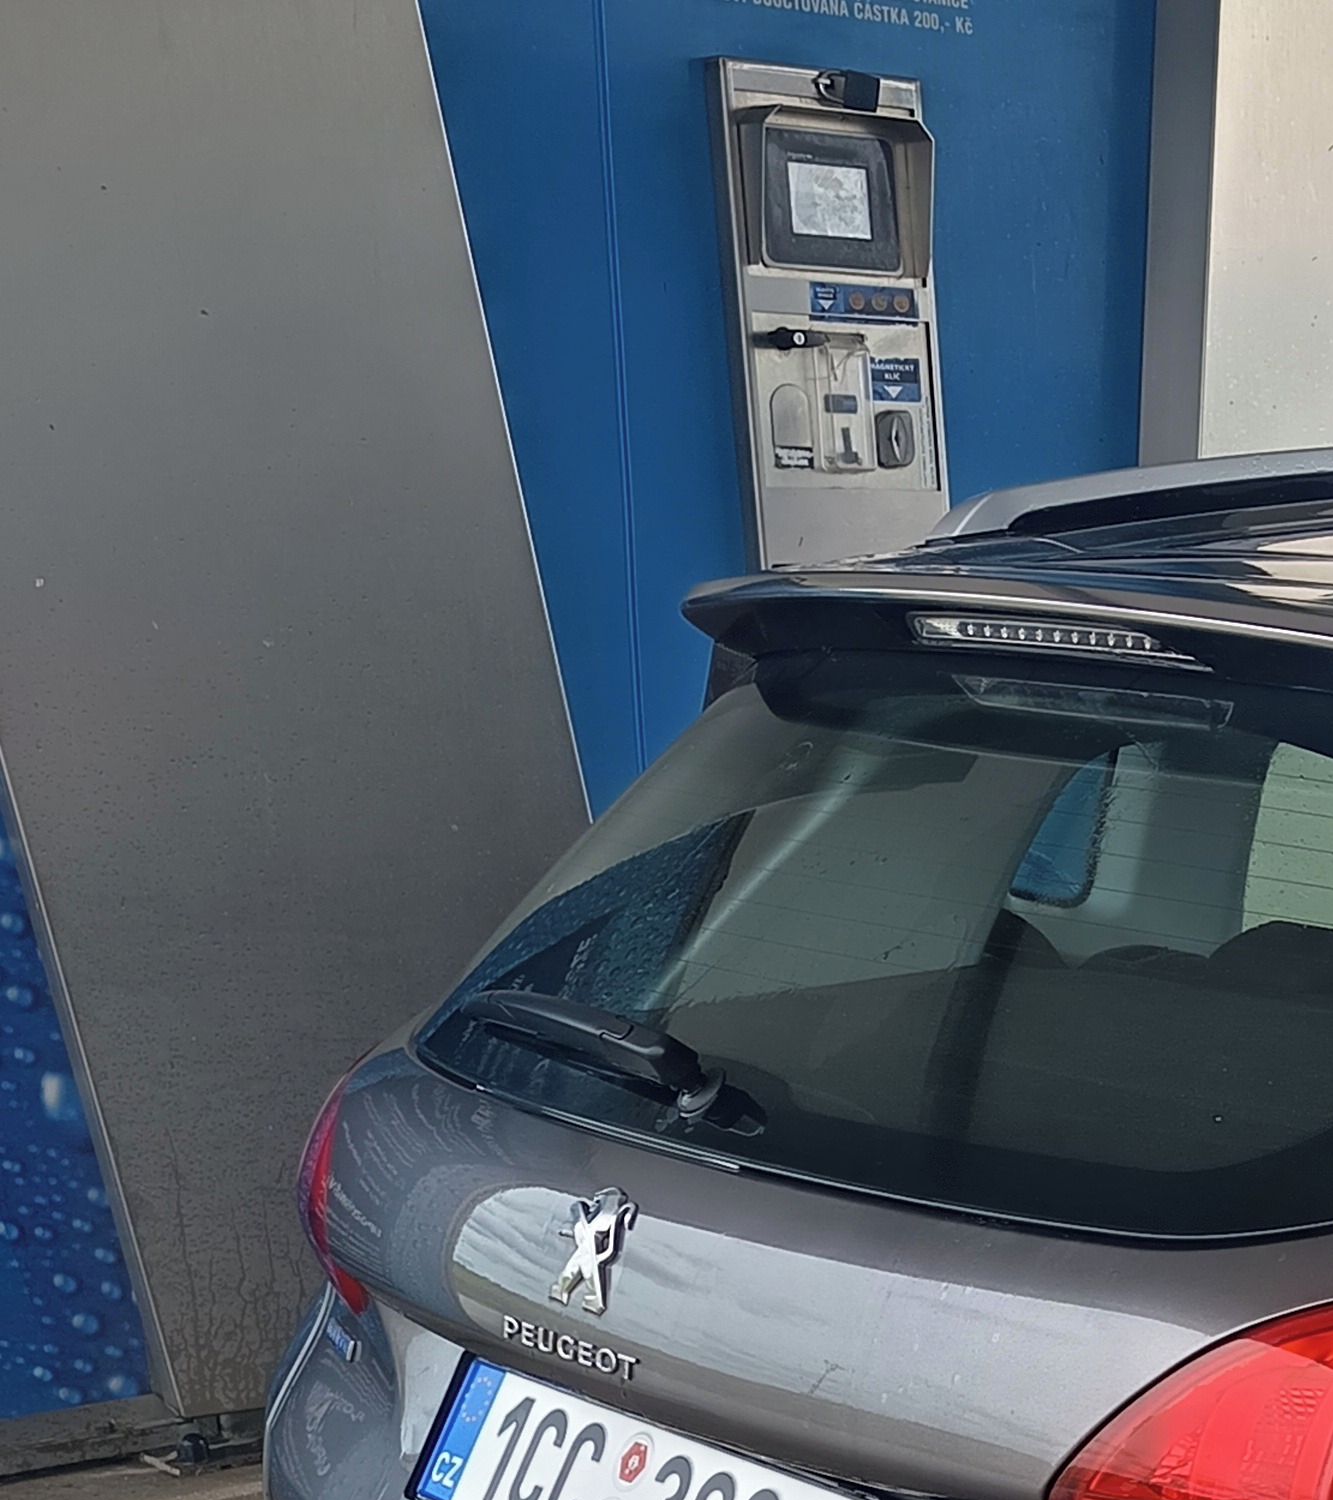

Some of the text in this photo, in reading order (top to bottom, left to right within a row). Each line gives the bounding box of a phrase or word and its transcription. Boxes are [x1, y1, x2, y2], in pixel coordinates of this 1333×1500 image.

[955, 16, 974, 35] Kč
[502, 1314, 641, 1382] PEUGEOT
[431, 1450, 462, 1488] CZ
